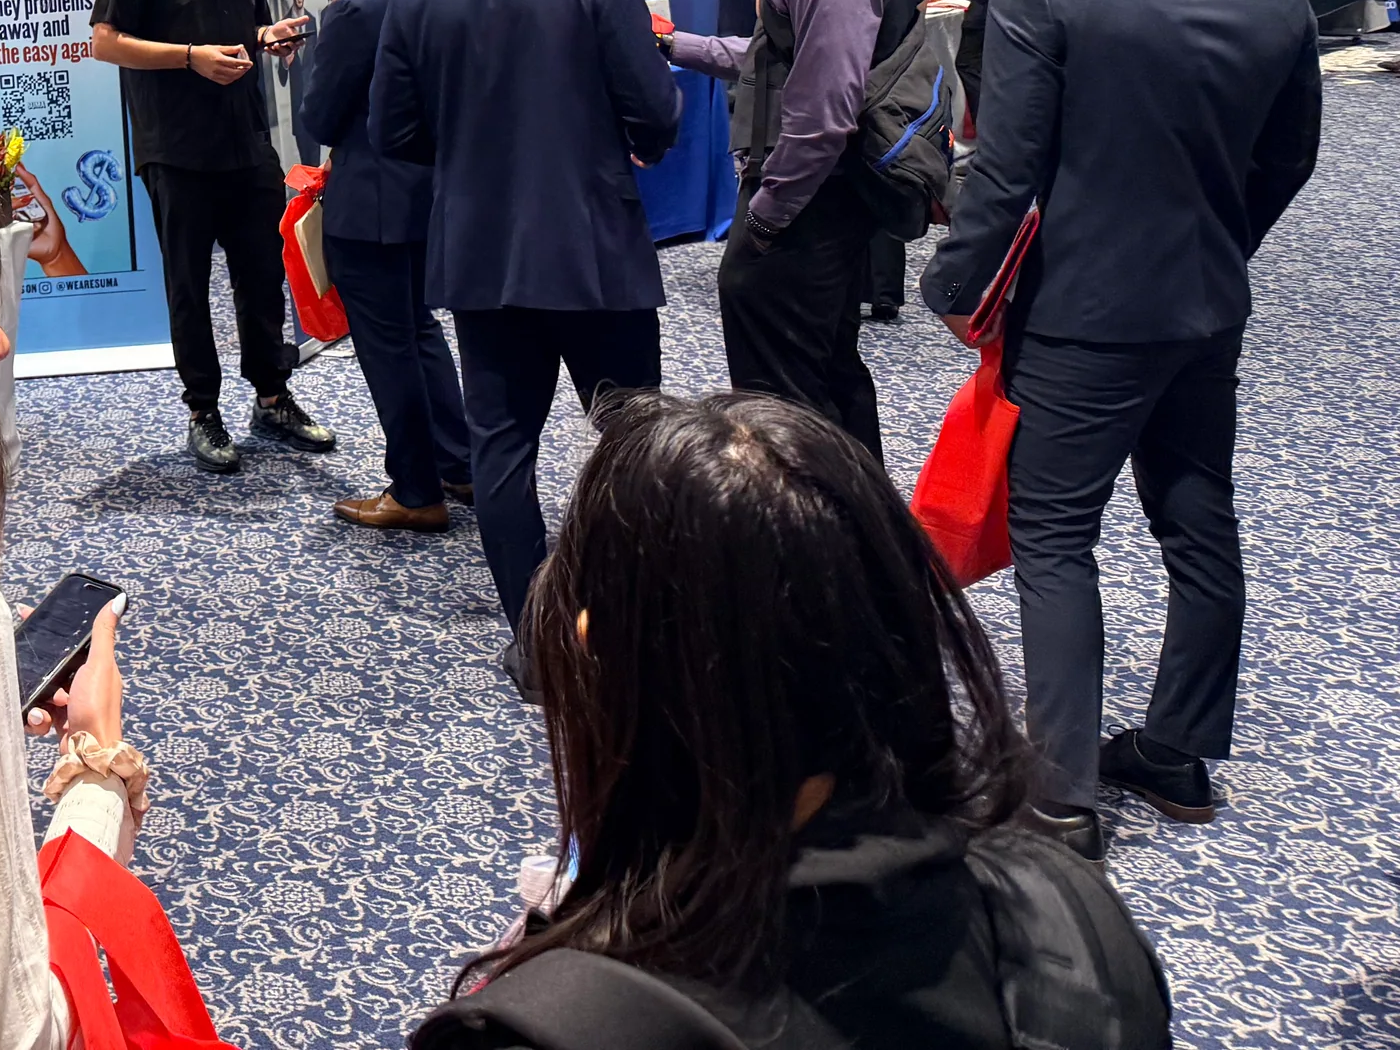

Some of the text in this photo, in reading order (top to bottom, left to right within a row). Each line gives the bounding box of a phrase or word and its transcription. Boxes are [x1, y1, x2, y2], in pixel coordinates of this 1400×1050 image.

[43, 15, 70, 37] and
[23, 44, 58, 66] easy
[62, 37, 93, 63] agai
[56, 278, 118, 291] @WEARESUMA
